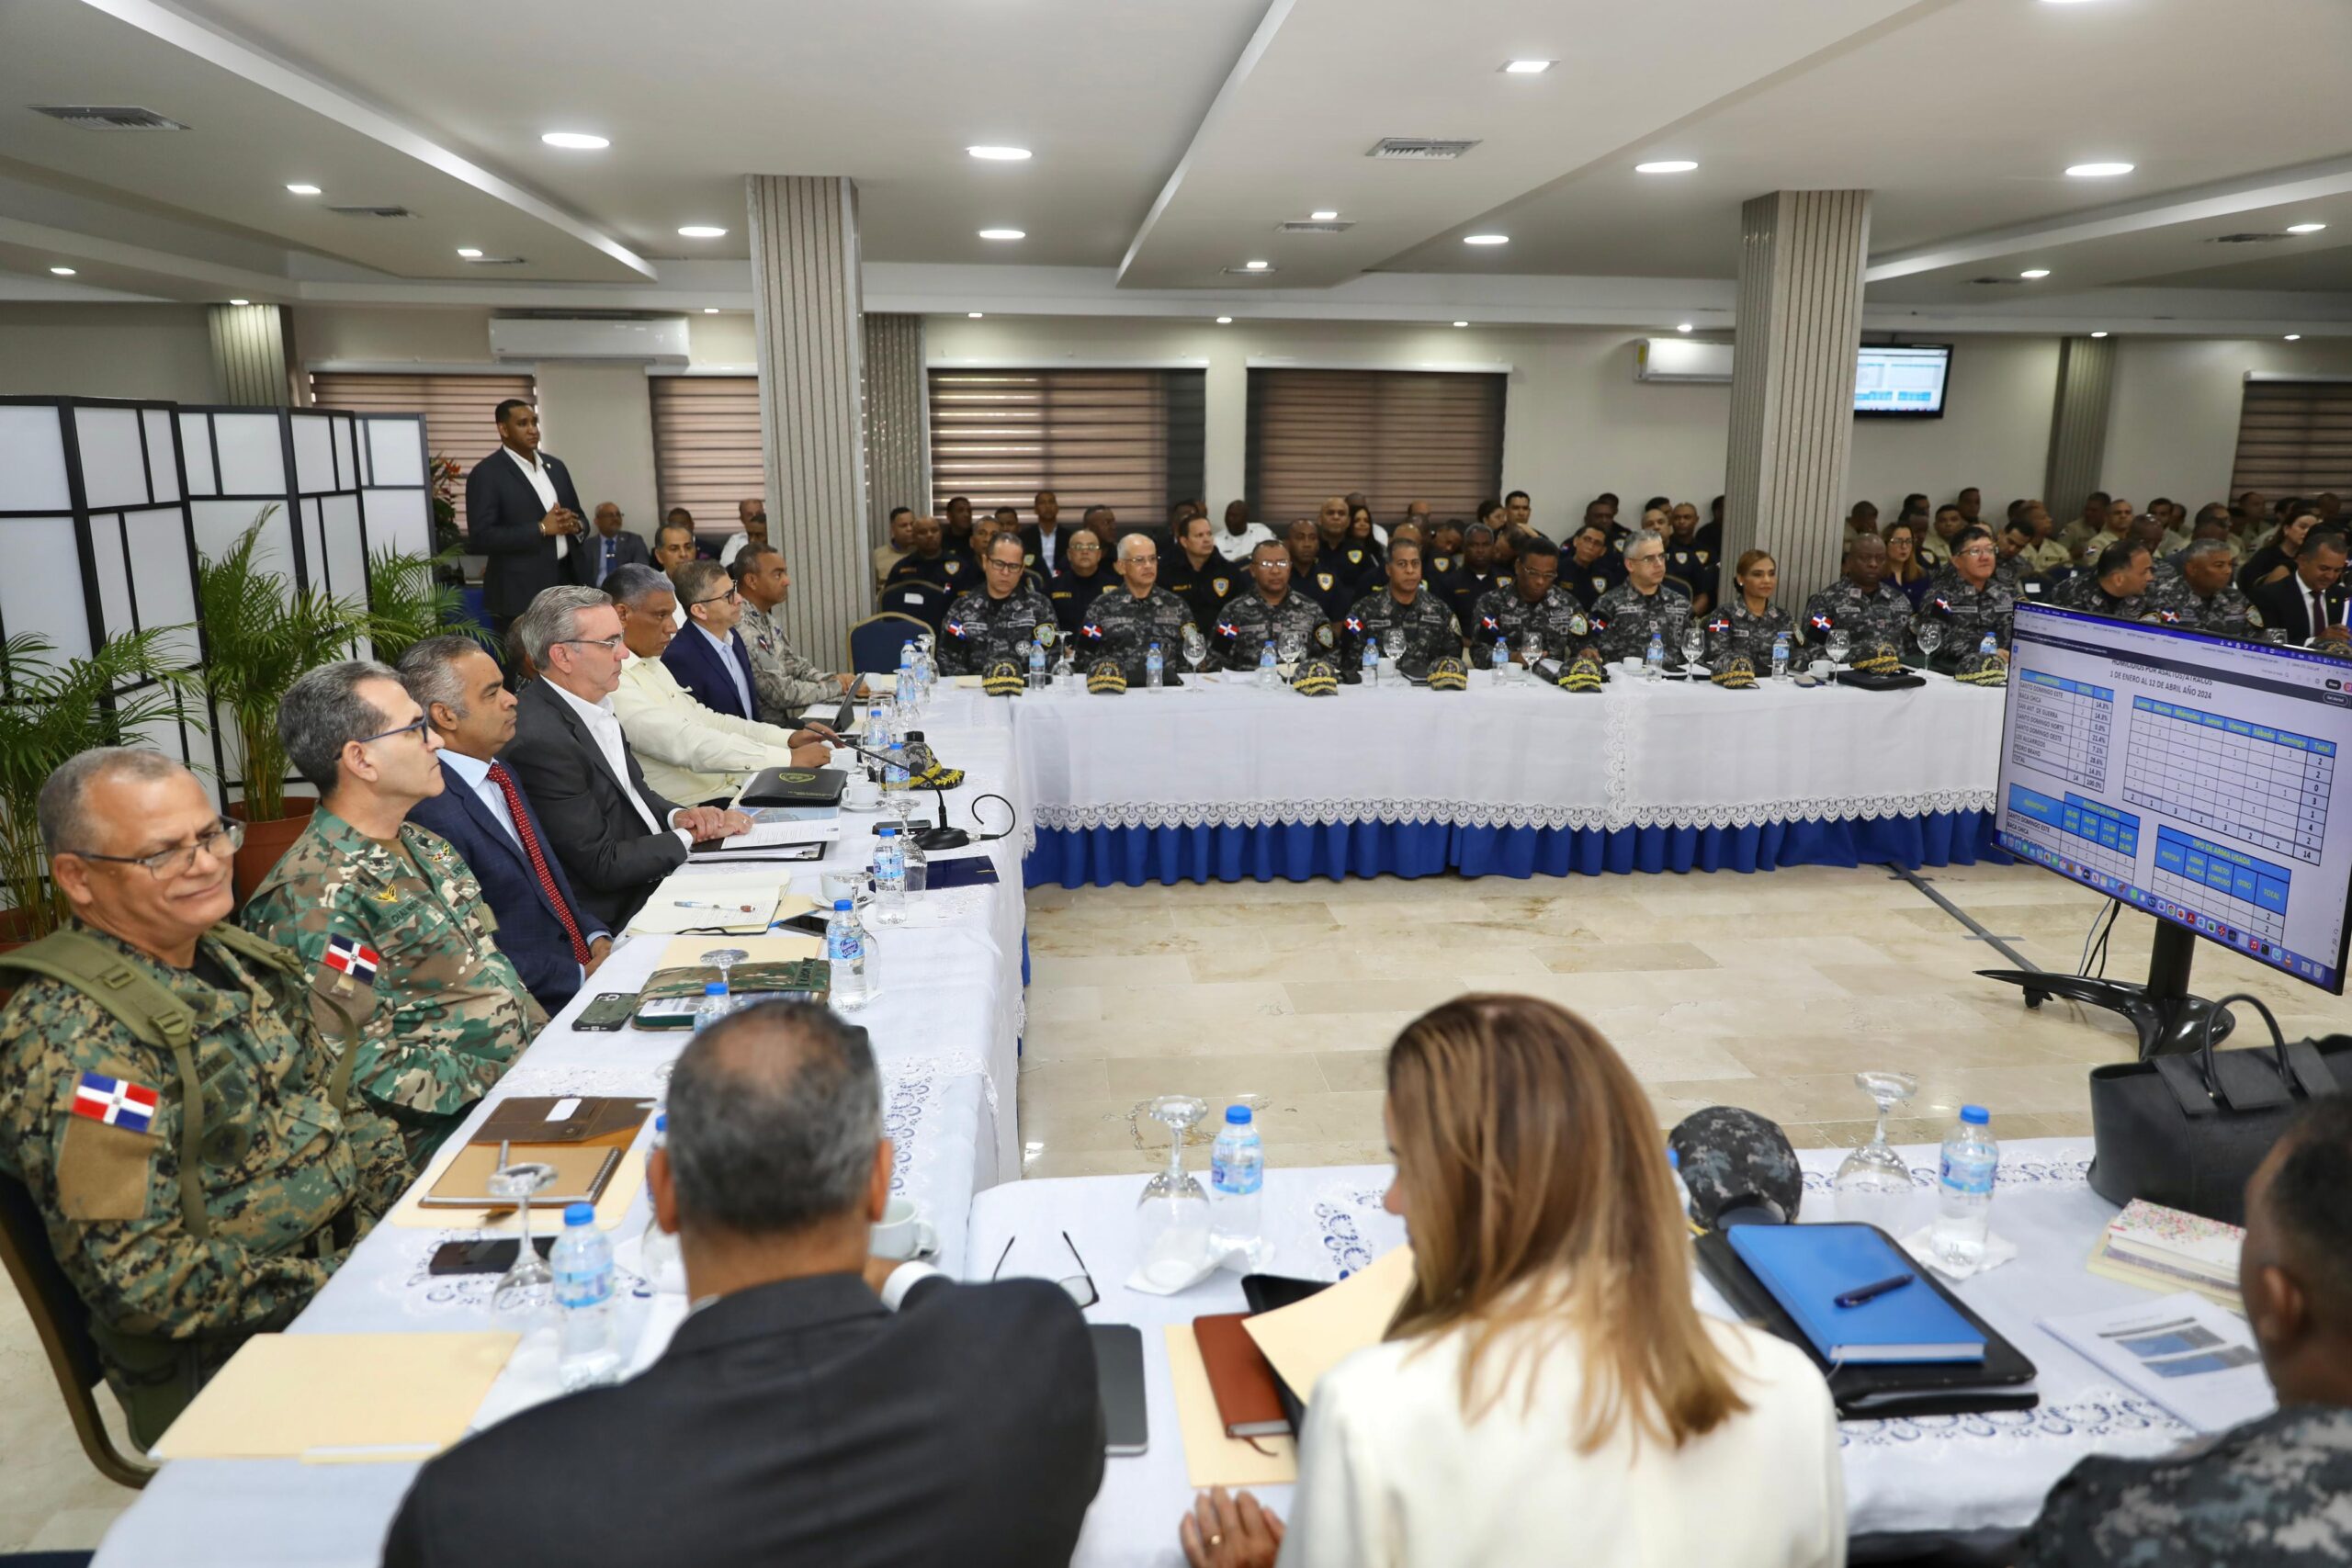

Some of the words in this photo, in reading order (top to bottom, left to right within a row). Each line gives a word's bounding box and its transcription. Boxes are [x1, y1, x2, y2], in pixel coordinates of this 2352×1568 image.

[2114, 671, 2121, 679] DE
[2121, 672, 2140, 683] ENERO
[2140, 676, 2147, 685] AL
[2148, 678, 2155, 687] 12
[2156, 680, 2164, 689] DE
[2165, 681, 2181, 693] ABRIL
[2182, 683, 2196, 695] AÑO
[2197, 688, 2211, 699] 2024
